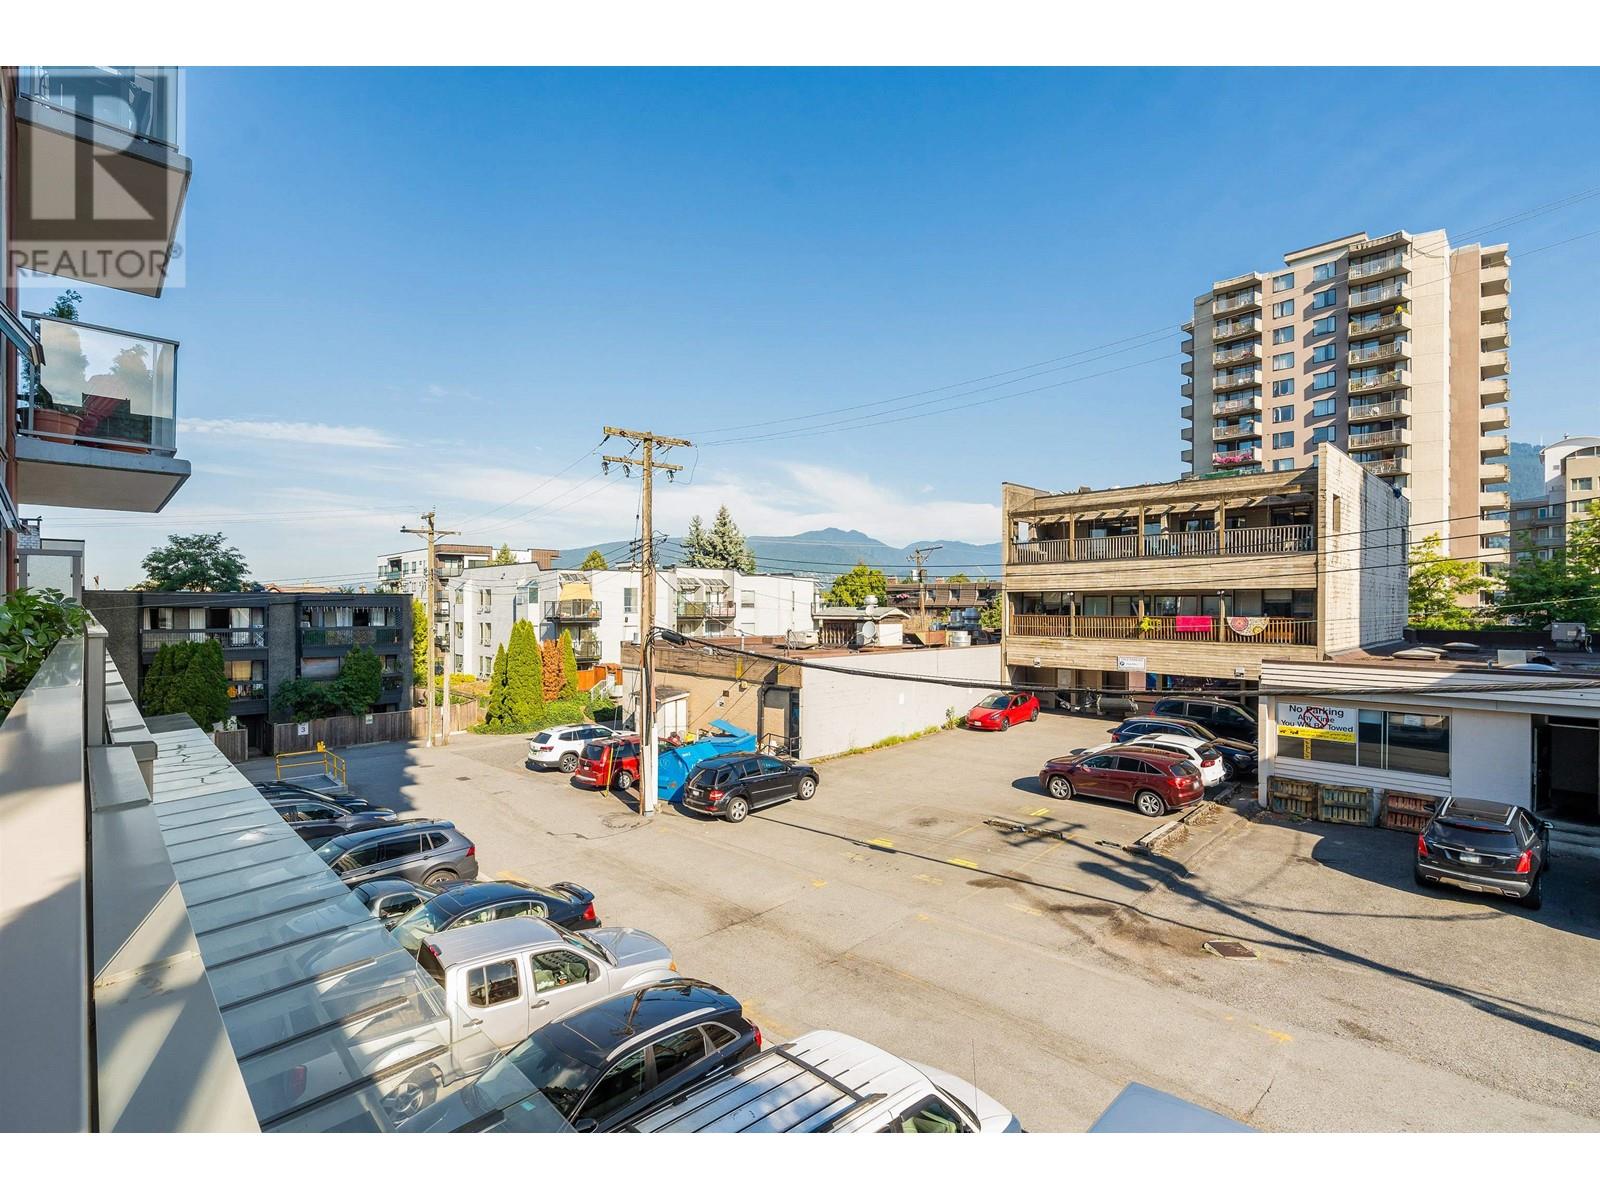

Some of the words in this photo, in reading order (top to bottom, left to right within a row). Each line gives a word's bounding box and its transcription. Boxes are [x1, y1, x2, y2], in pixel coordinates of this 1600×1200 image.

[1289, 704, 1303, 713] No
[1307, 706, 1344, 718] Parking
[1281, 719, 1295, 727] You
[1329, 724, 1355, 733] Towed
